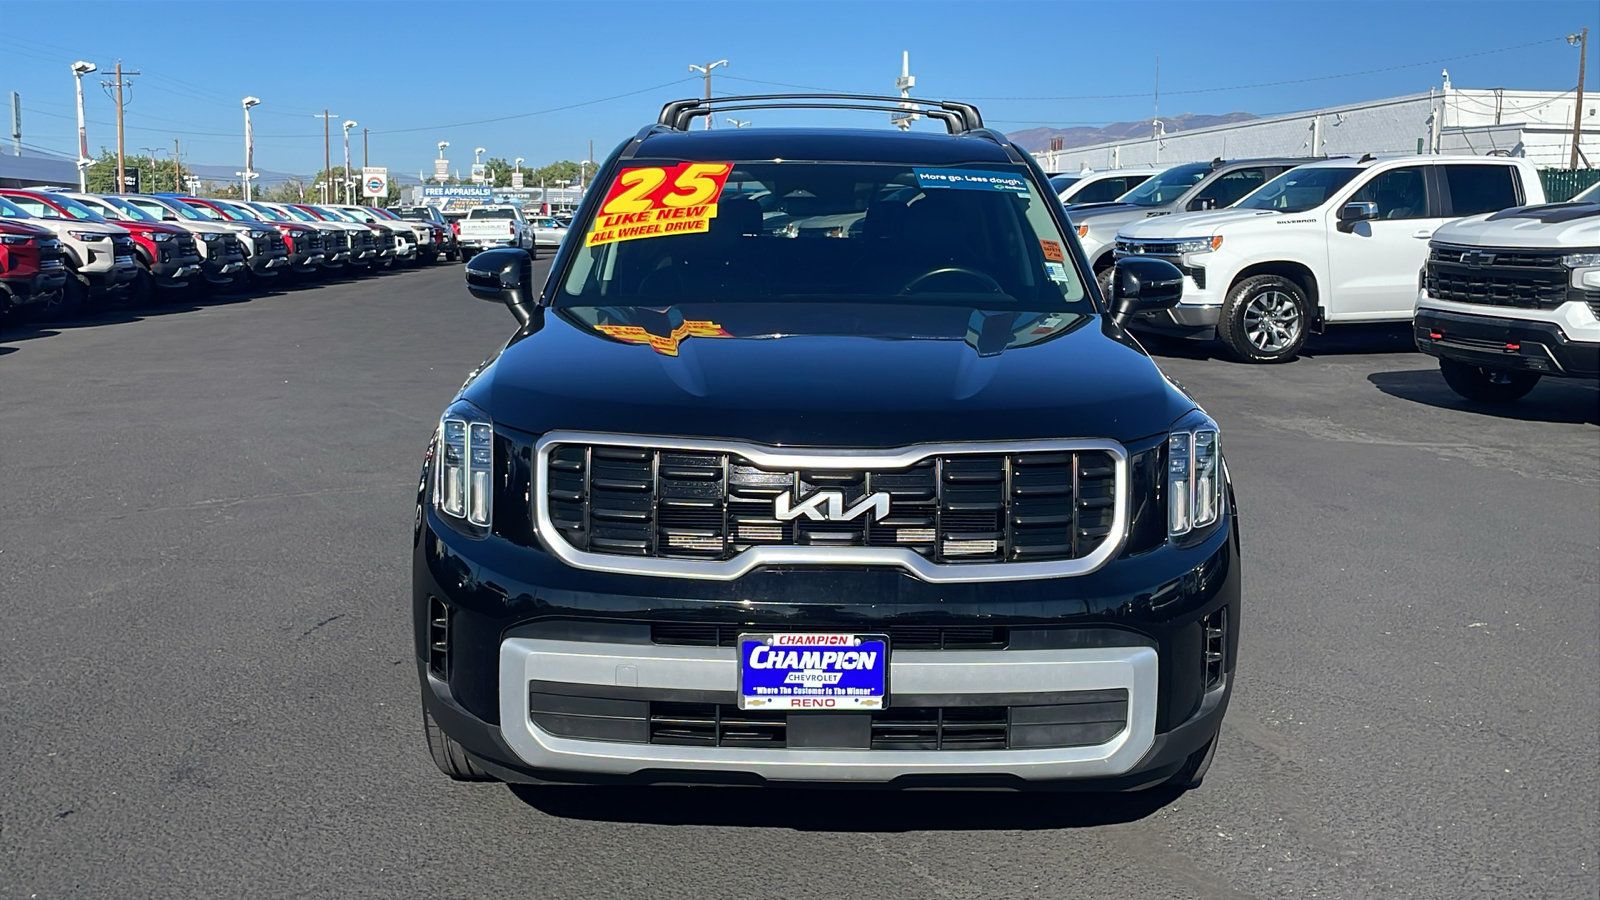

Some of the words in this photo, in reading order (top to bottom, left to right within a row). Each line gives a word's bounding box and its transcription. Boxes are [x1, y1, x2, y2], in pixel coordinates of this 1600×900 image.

[989, 176, 1024, 186] dough.
[425, 188, 443, 196] FREE
[444, 187, 491, 196] APPRAISALS!
[603, 163, 729, 214] 25
[603, 211, 653, 228] LIKE
[656, 205, 710, 221] NEW
[590, 232, 615, 244] ALL
[618, 223, 661, 239] WHEEL
[665, 219, 706, 233] DRIVE
[775, 491, 889, 521] KIA
[779, 635, 849, 645] CHAMPION
[749, 645, 877, 670] CHAMPION
[788, 674, 839, 682] CHEVROLET
[779, 687, 792, 695] The
[793, 687, 825, 695] Customer
[826, 687, 833, 695] Is
[834, 687, 846, 695] The
[791, 698, 836, 708] RENO
